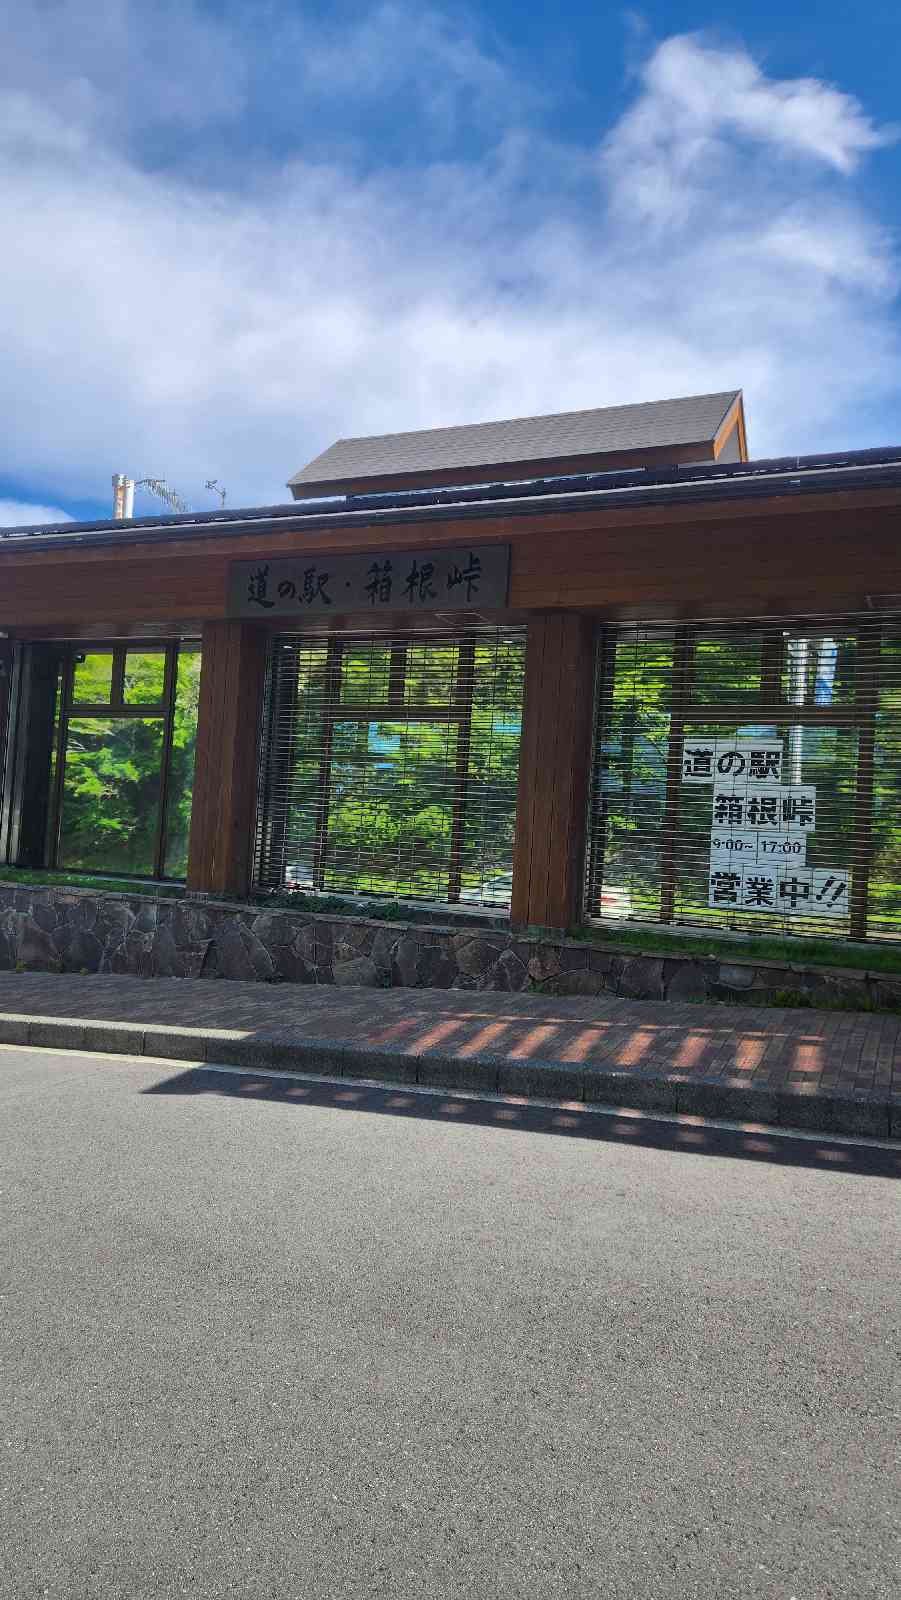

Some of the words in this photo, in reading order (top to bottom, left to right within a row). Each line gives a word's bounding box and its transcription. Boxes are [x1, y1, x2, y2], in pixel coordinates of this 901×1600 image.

[684, 748, 780, 779] 道の駅
[714, 794, 814, 827] 箱根峠
